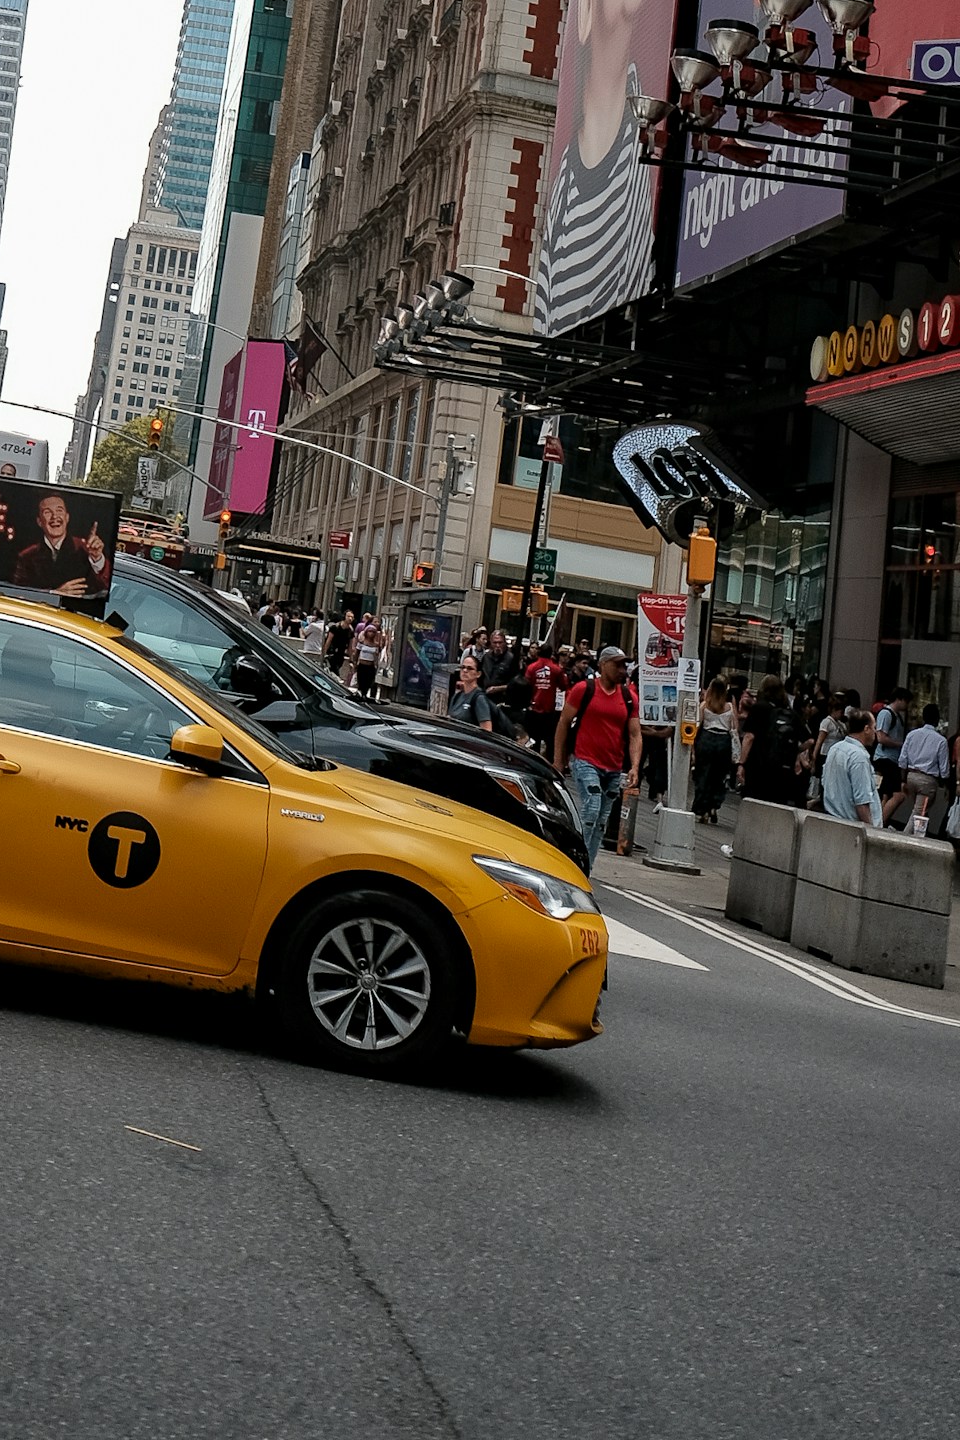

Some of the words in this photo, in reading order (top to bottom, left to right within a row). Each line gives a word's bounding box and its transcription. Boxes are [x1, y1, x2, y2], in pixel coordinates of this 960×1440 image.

[684, 154, 736, 249] night
[828, 340, 838, 368] N
[846, 333, 855, 363] Q
[863, 328, 872, 358] R
[880, 325, 893, 361] W
[900, 315, 911, 349] S
[923, 309, 929, 342] 1
[941, 302, 952, 338] 2
[1, 442, 33, 457] 47844
[534, 562, 555, 573] outh
[641, 596, 668, 605] Hop-On
[280, 807, 325, 822] HYBRID
[55, 815, 89, 833] NYC
[107, 825, 146, 879] T
[580, 928, 600, 954] 262
